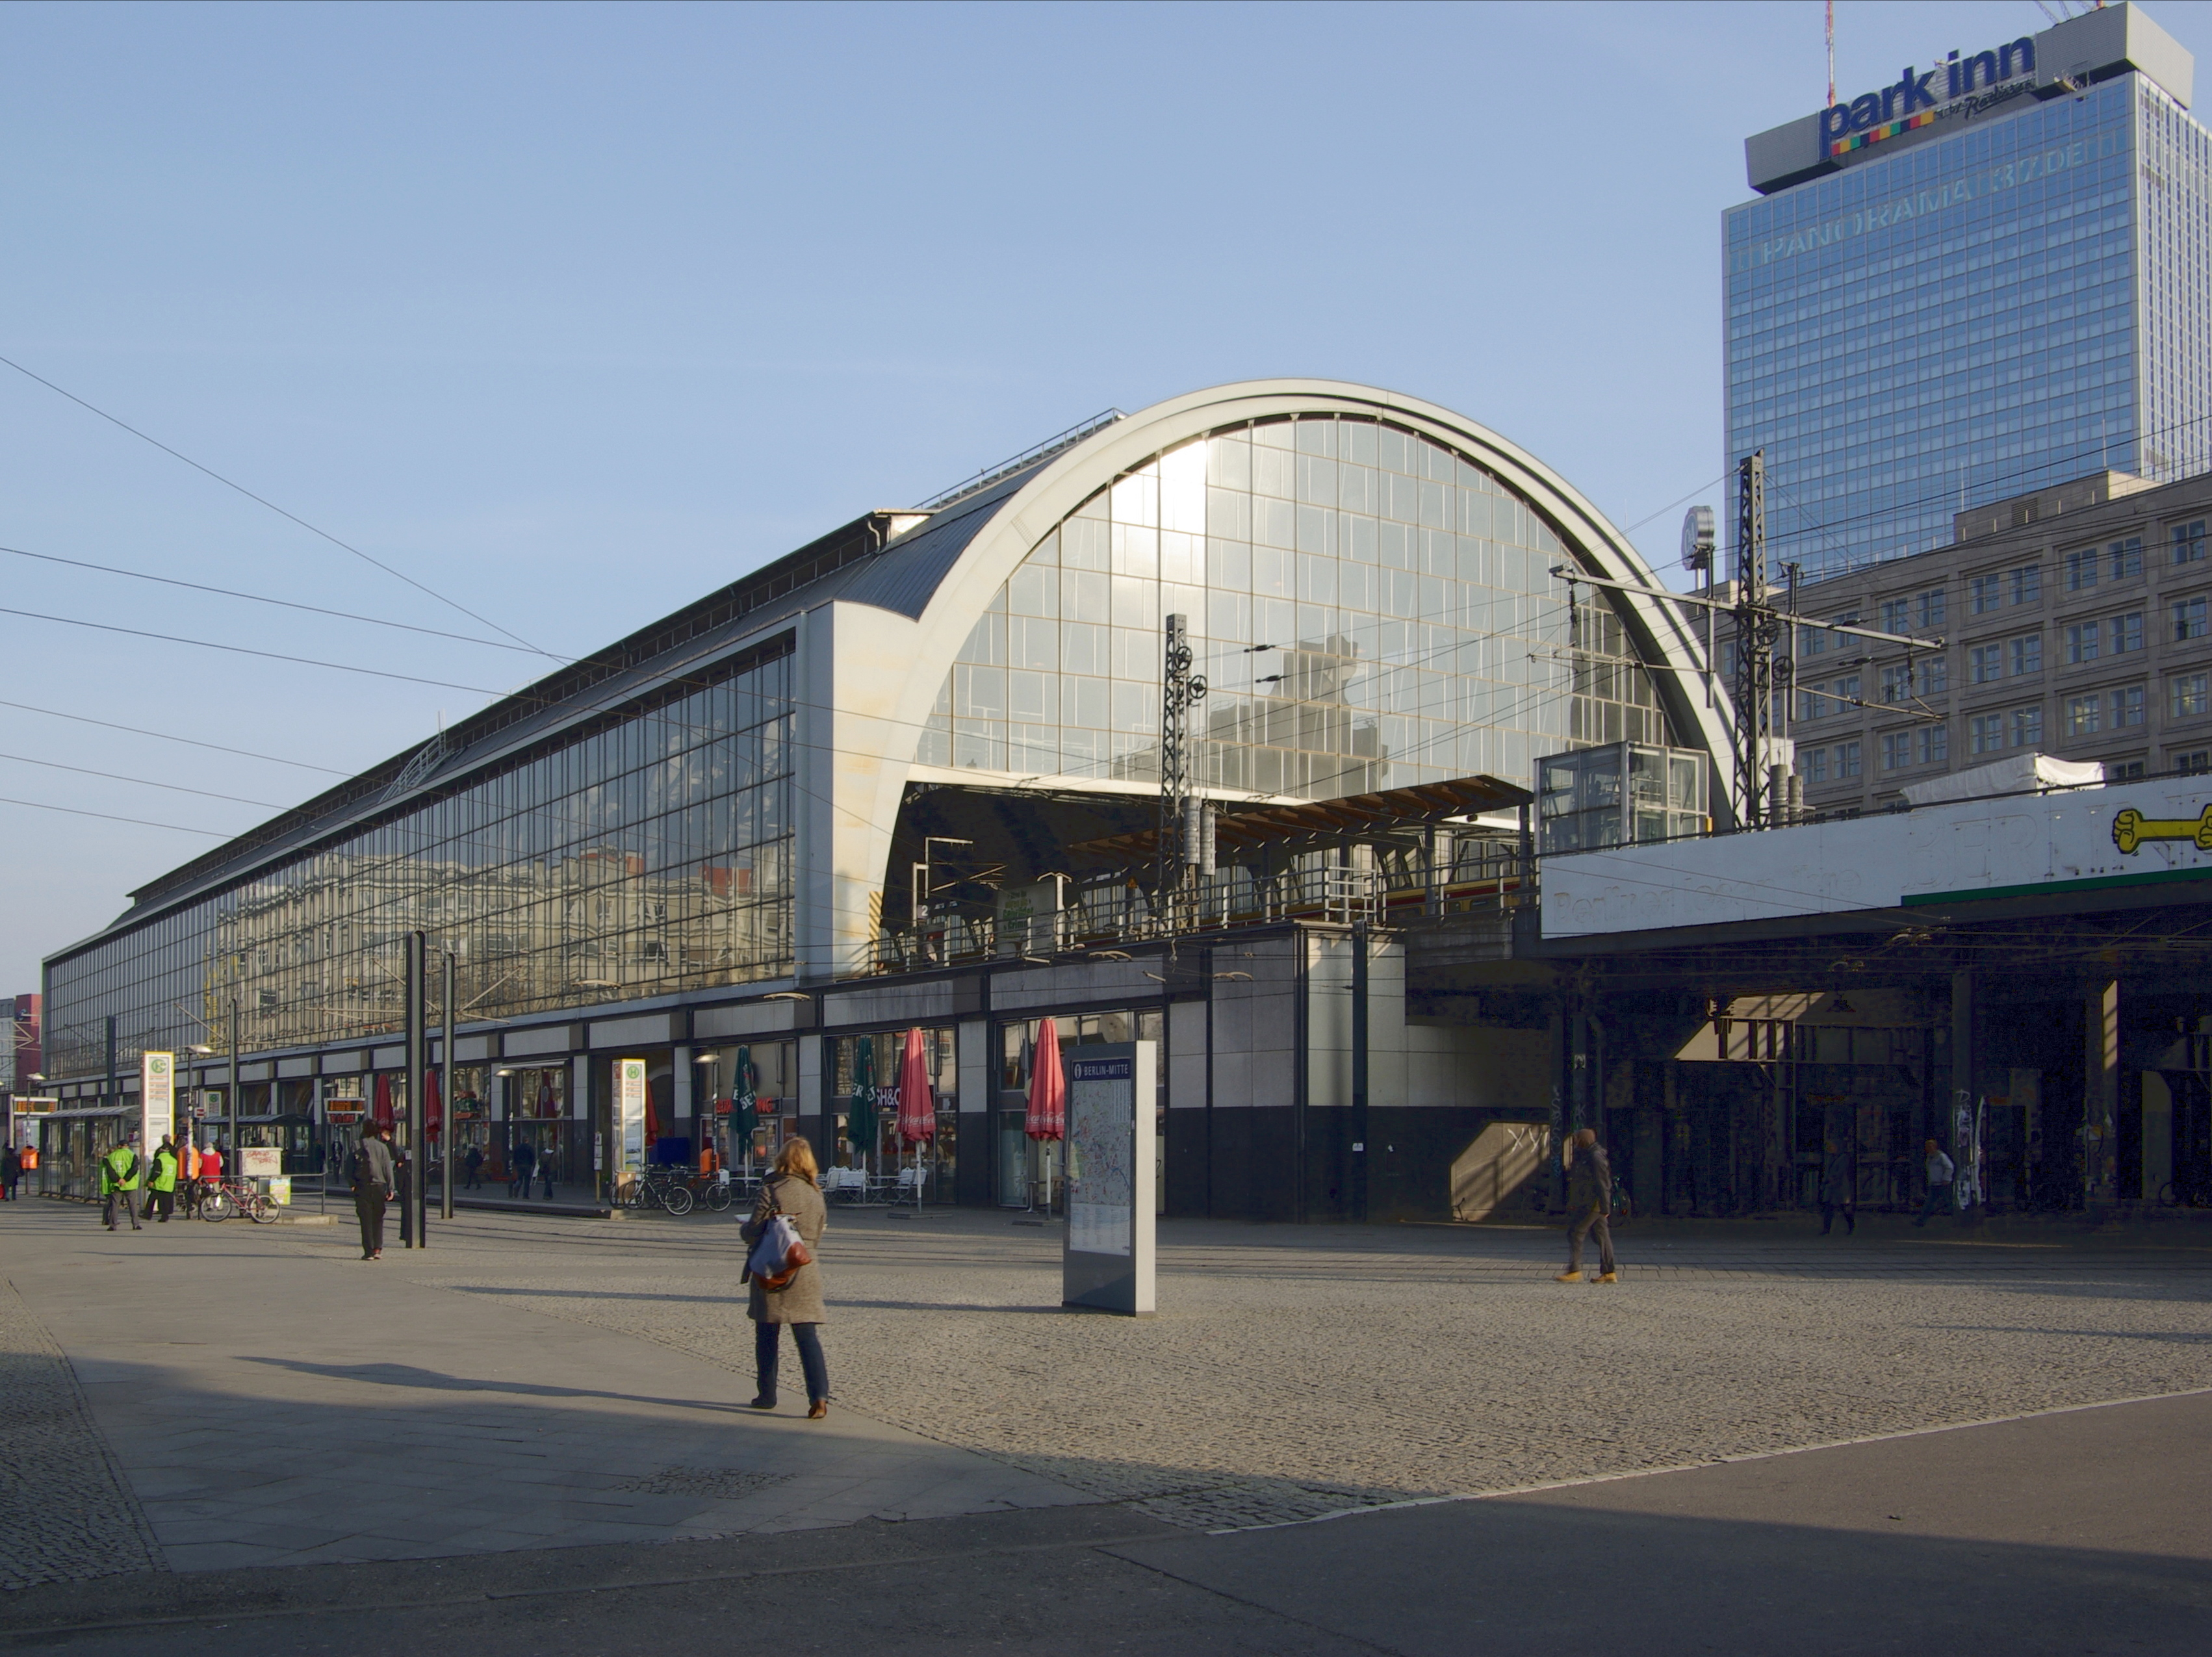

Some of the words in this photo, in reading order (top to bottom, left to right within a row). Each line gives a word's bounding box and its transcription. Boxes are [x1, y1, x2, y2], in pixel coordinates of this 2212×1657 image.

[1819, 66, 1938, 161] park
[1948, 36, 2036, 98] inn
[921, 905, 929, 916] 2
[1083, 1064, 1129, 1076] BERLIN-MITTE
